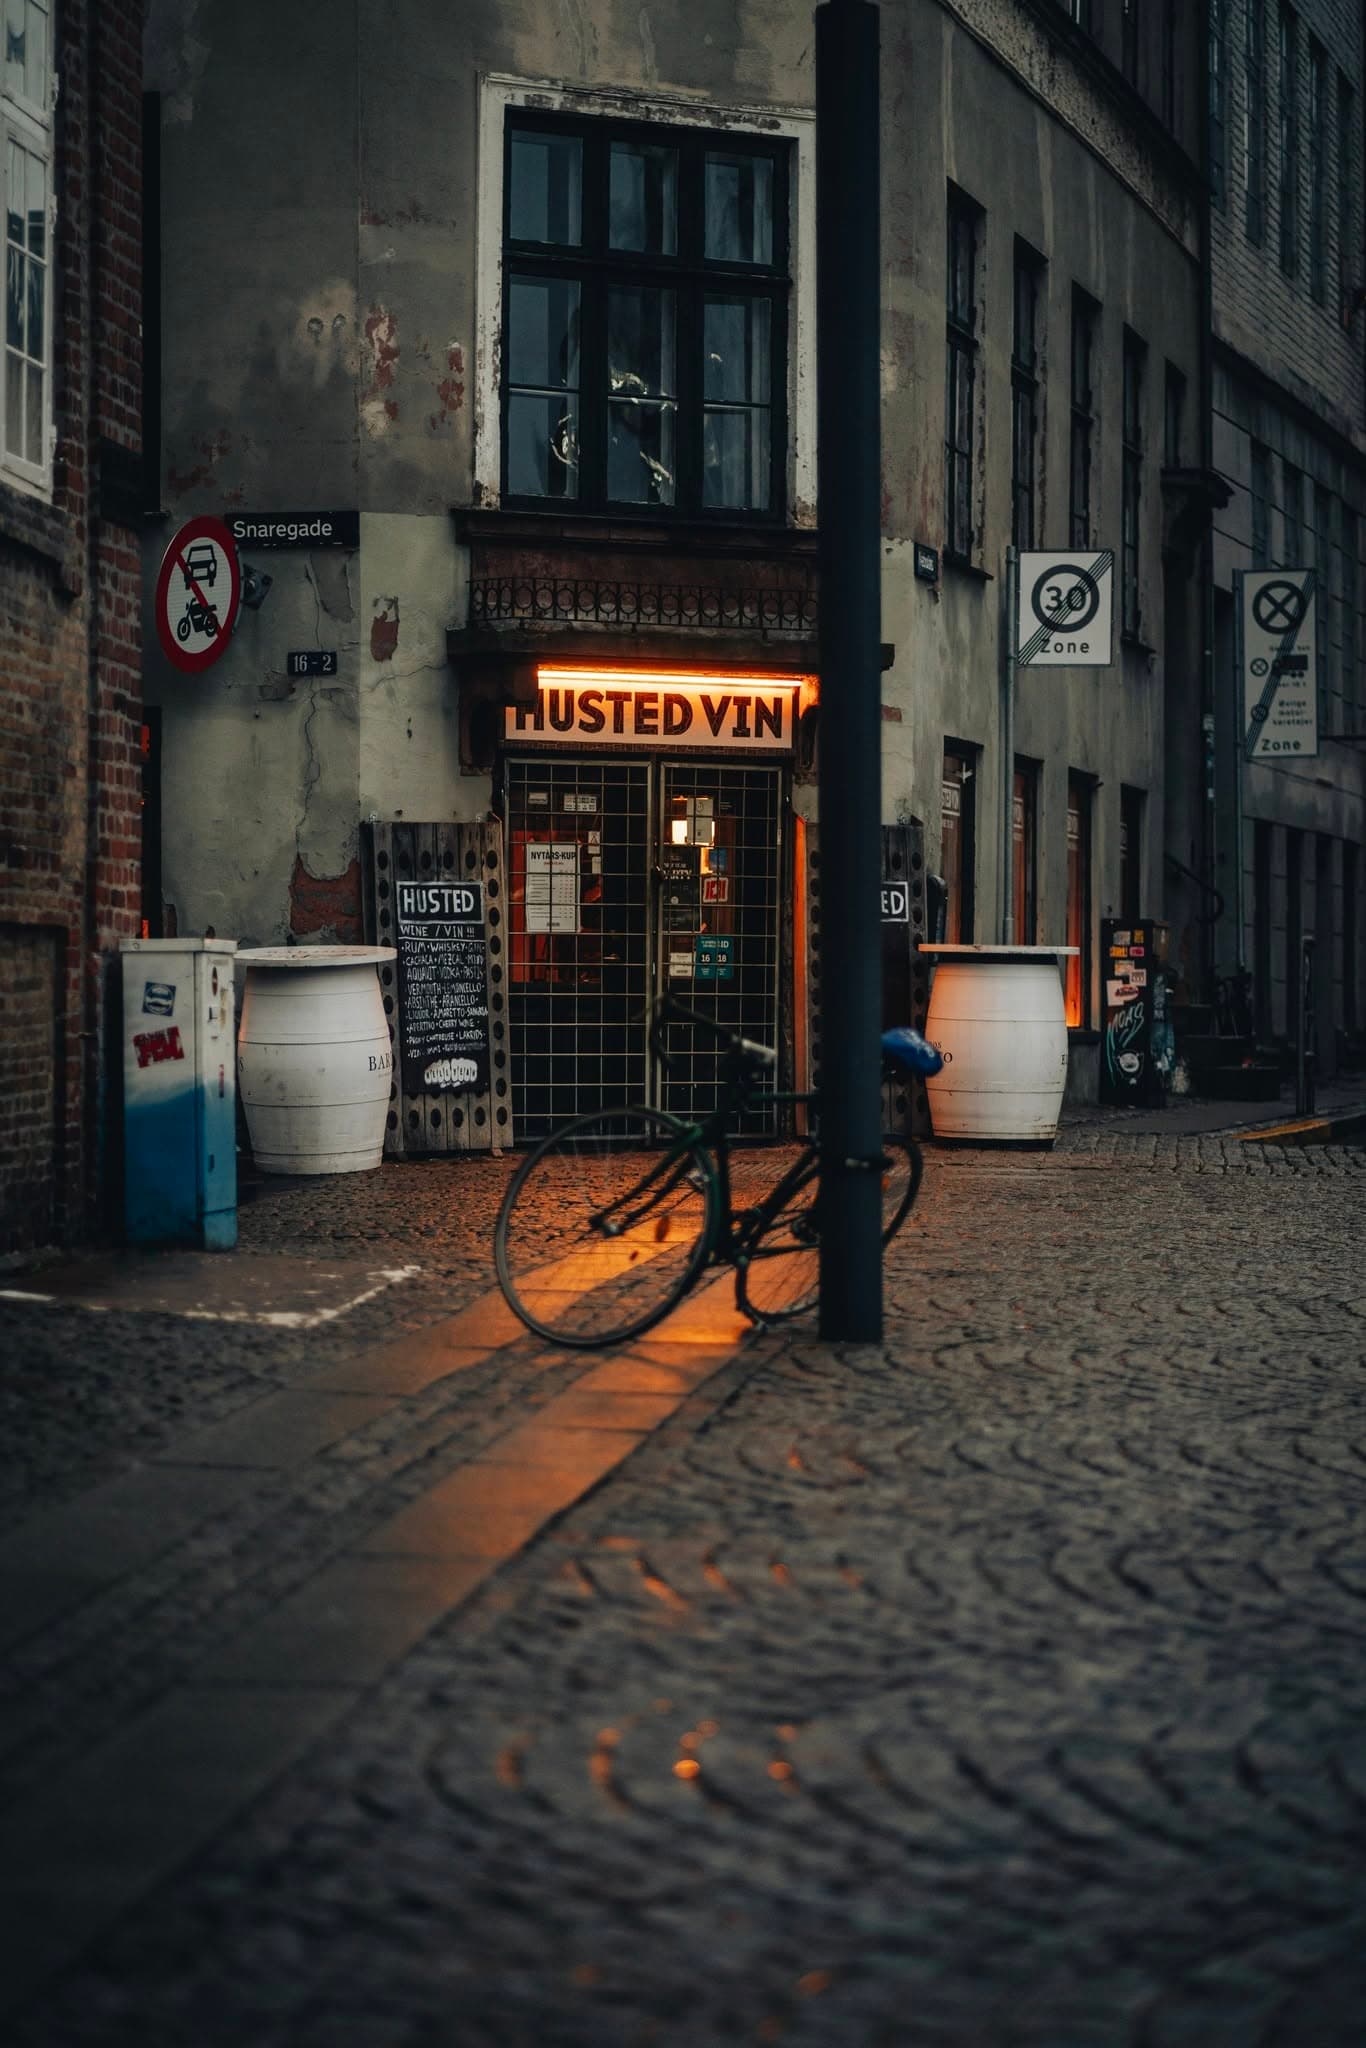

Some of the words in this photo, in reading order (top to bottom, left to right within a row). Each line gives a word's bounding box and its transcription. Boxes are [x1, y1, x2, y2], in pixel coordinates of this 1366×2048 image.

[233, 519, 333, 540] Snaregade
[1045, 586, 1087, 611] 30
[1041, 639, 1090, 654] Zone
[294, 654, 307, 672] 16
[322, 654, 331, 671] 2
[699, 694, 783, 740] VIN
[1262, 739, 1302, 751] Zone
[404, 888, 474, 913] HUSTED
[400, 925, 429, 936] WINE
[444, 925, 463, 938] VIN
[701, 953, 710, 963] 16
[717, 953, 727, 963] 18
